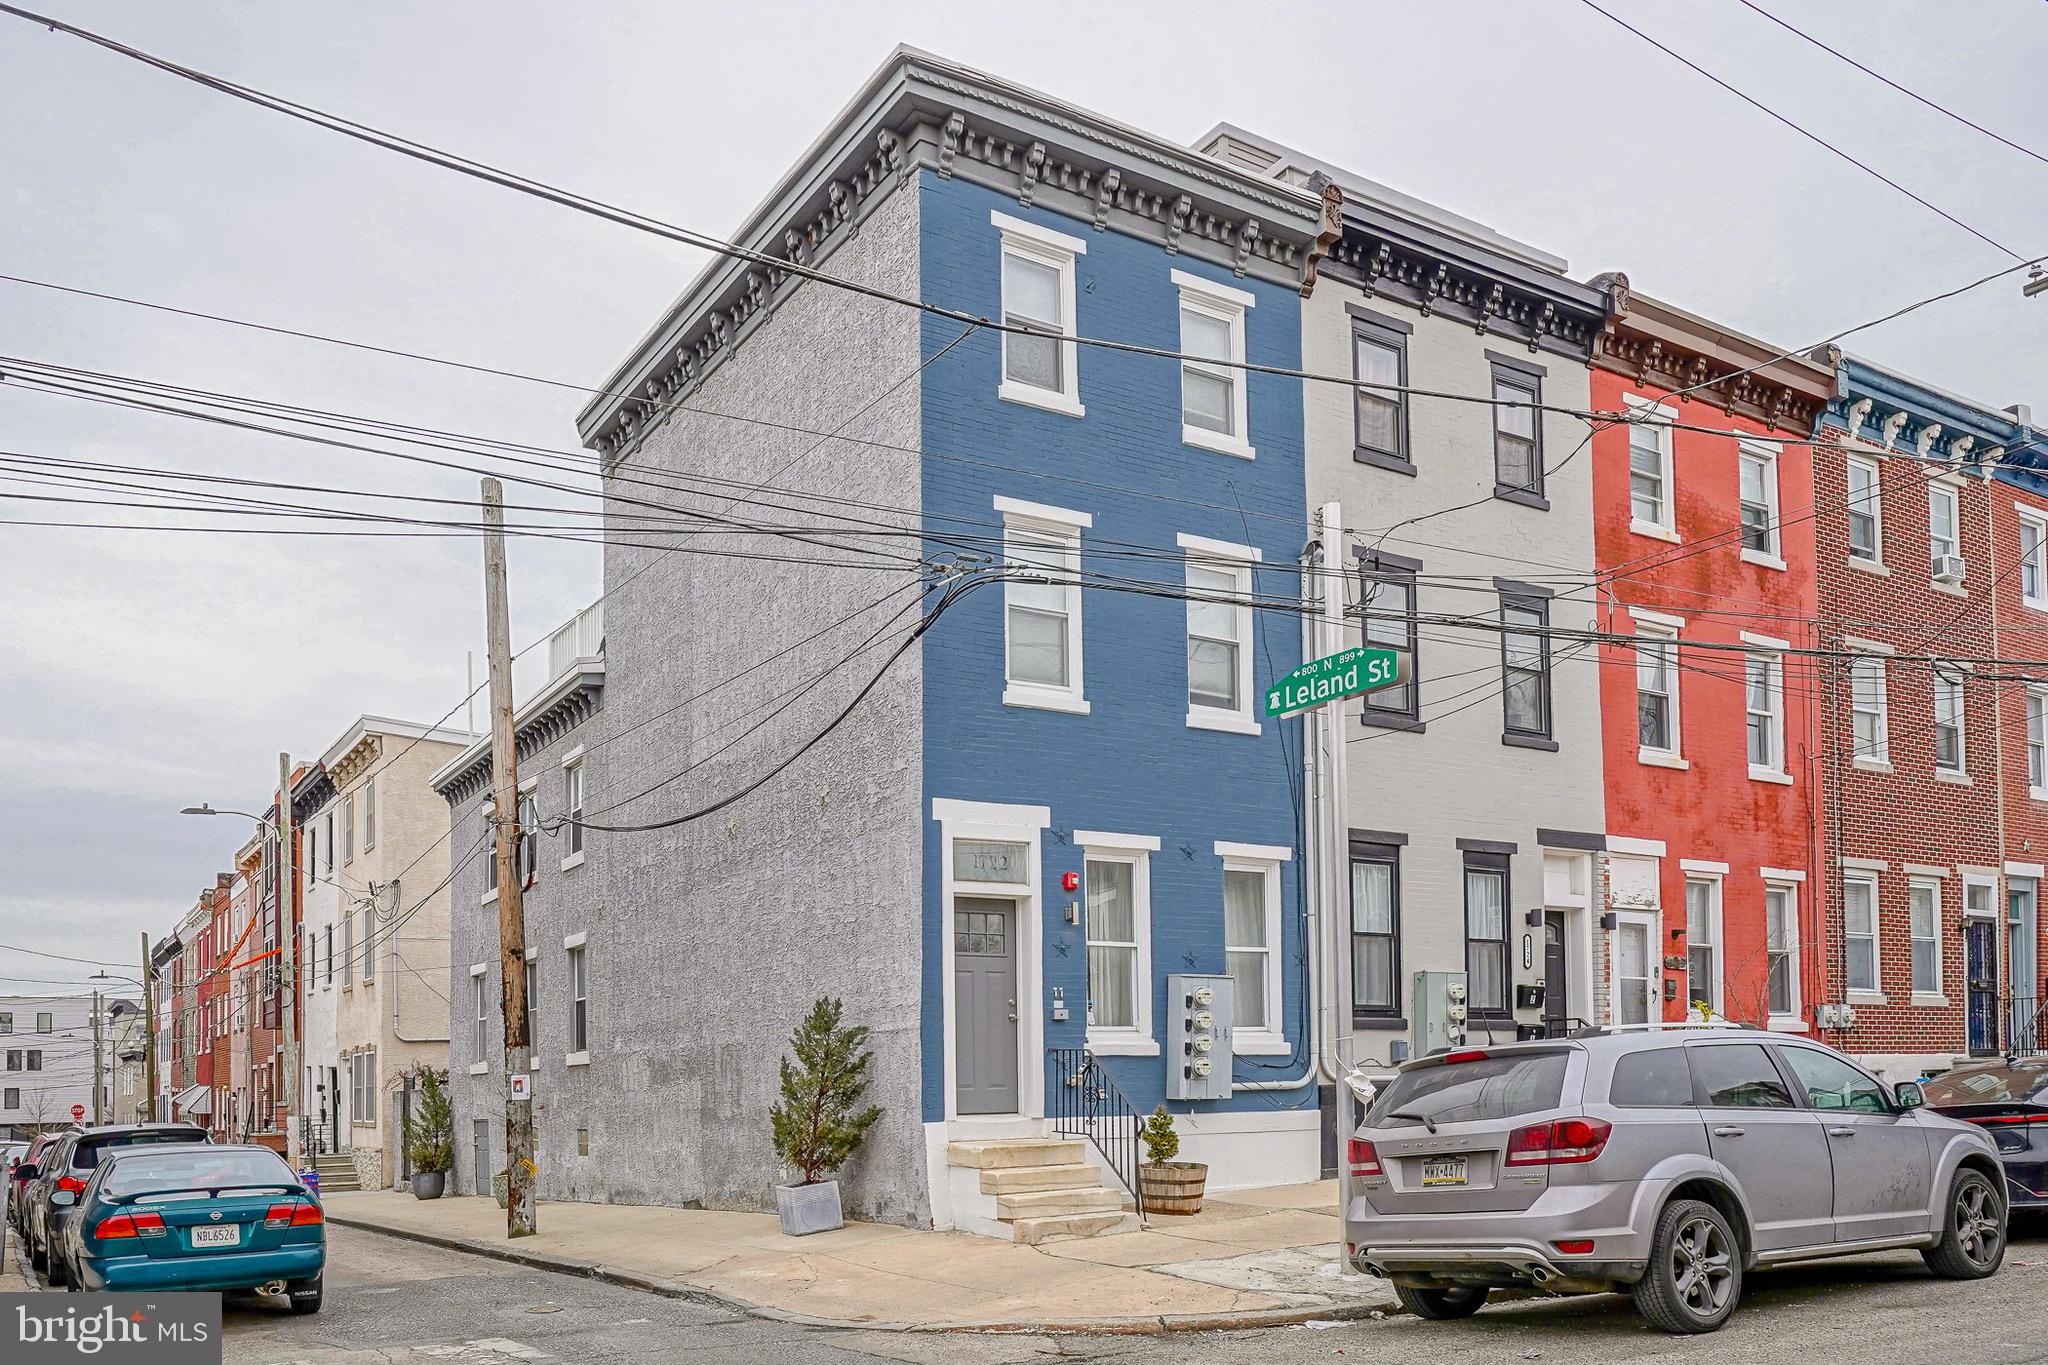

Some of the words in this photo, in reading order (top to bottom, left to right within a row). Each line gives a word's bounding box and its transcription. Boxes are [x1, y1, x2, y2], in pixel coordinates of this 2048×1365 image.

[1301, 663, 1318, 677] 800
[1323, 658, 1332, 672] N
[1339, 652, 1356, 665] 899
[1285, 664, 1358, 708] Leland
[1368, 657, 1391, 683] St
[196, 1229, 235, 1242] NBL6526
[294, 1289, 318, 1297] NISSAN
